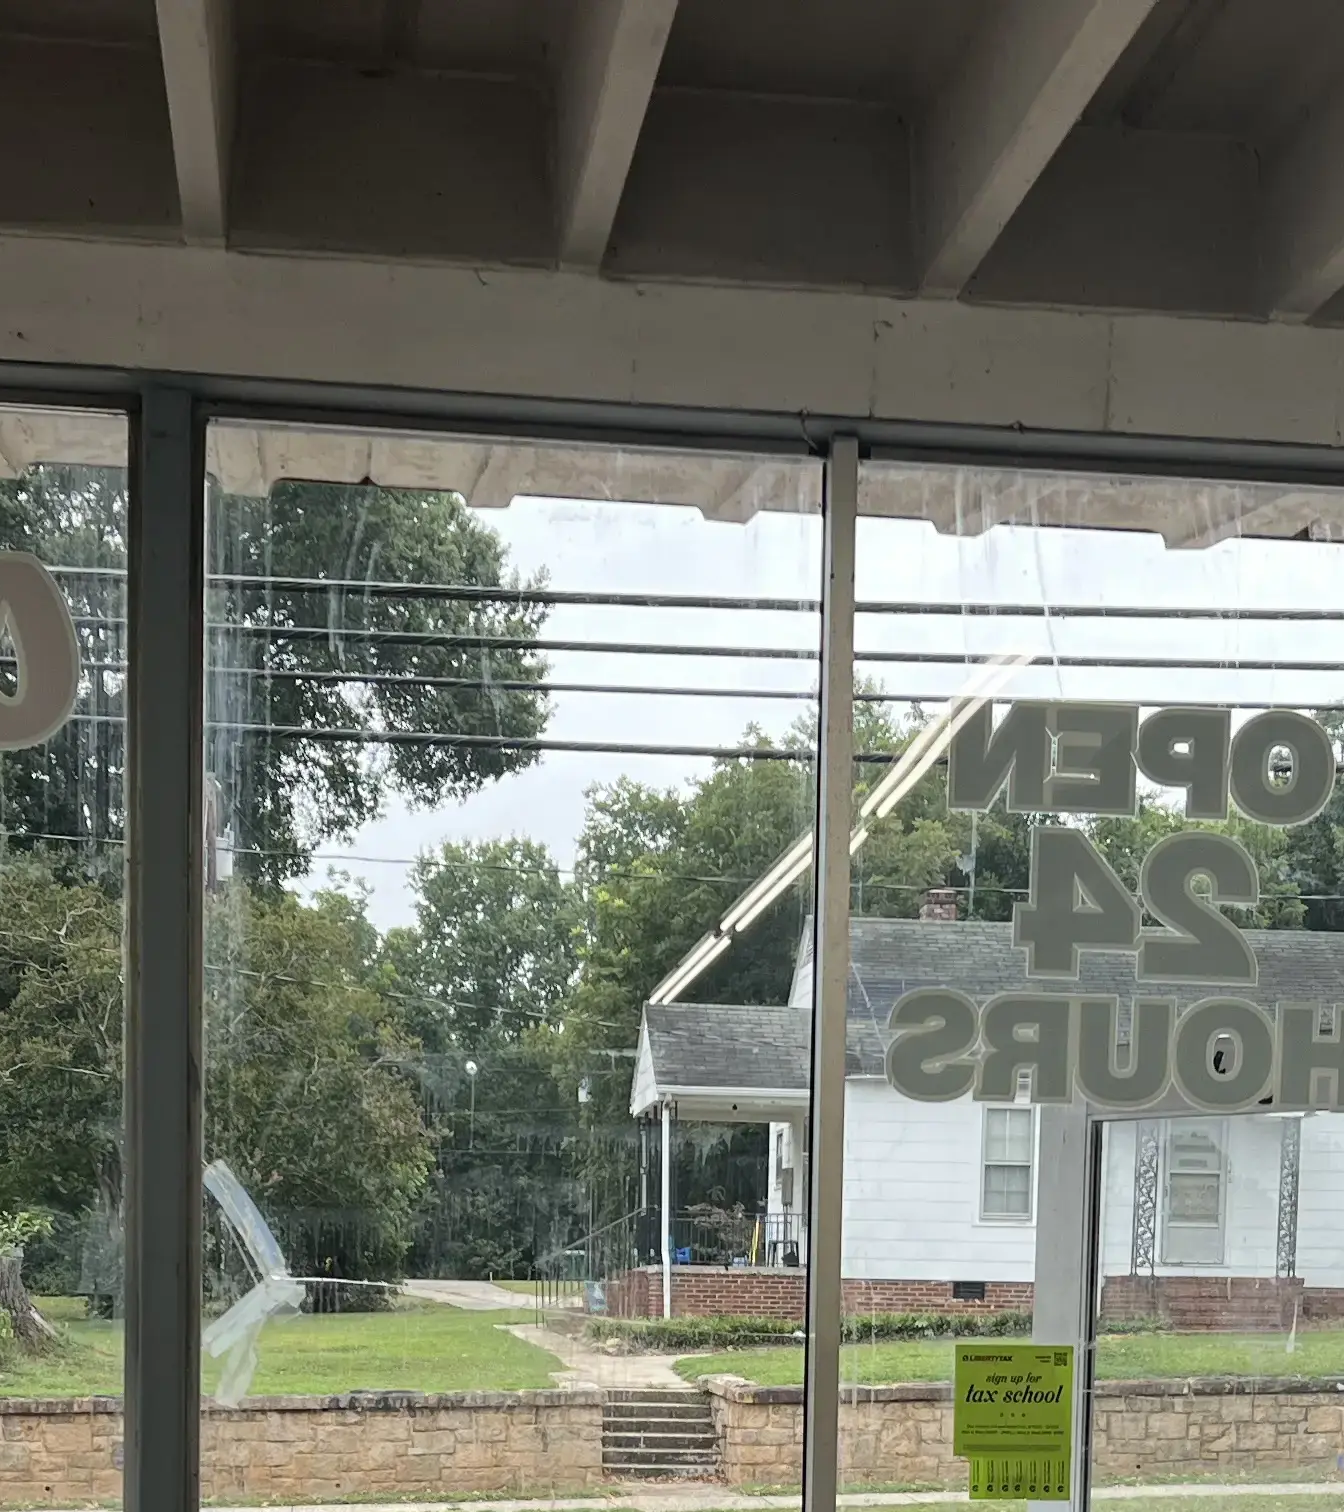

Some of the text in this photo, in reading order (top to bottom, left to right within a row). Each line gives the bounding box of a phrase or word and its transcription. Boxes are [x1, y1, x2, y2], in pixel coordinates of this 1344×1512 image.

[986, 1372, 1043, 1386] sign up for
[965, 1384, 1064, 1403] tax school
